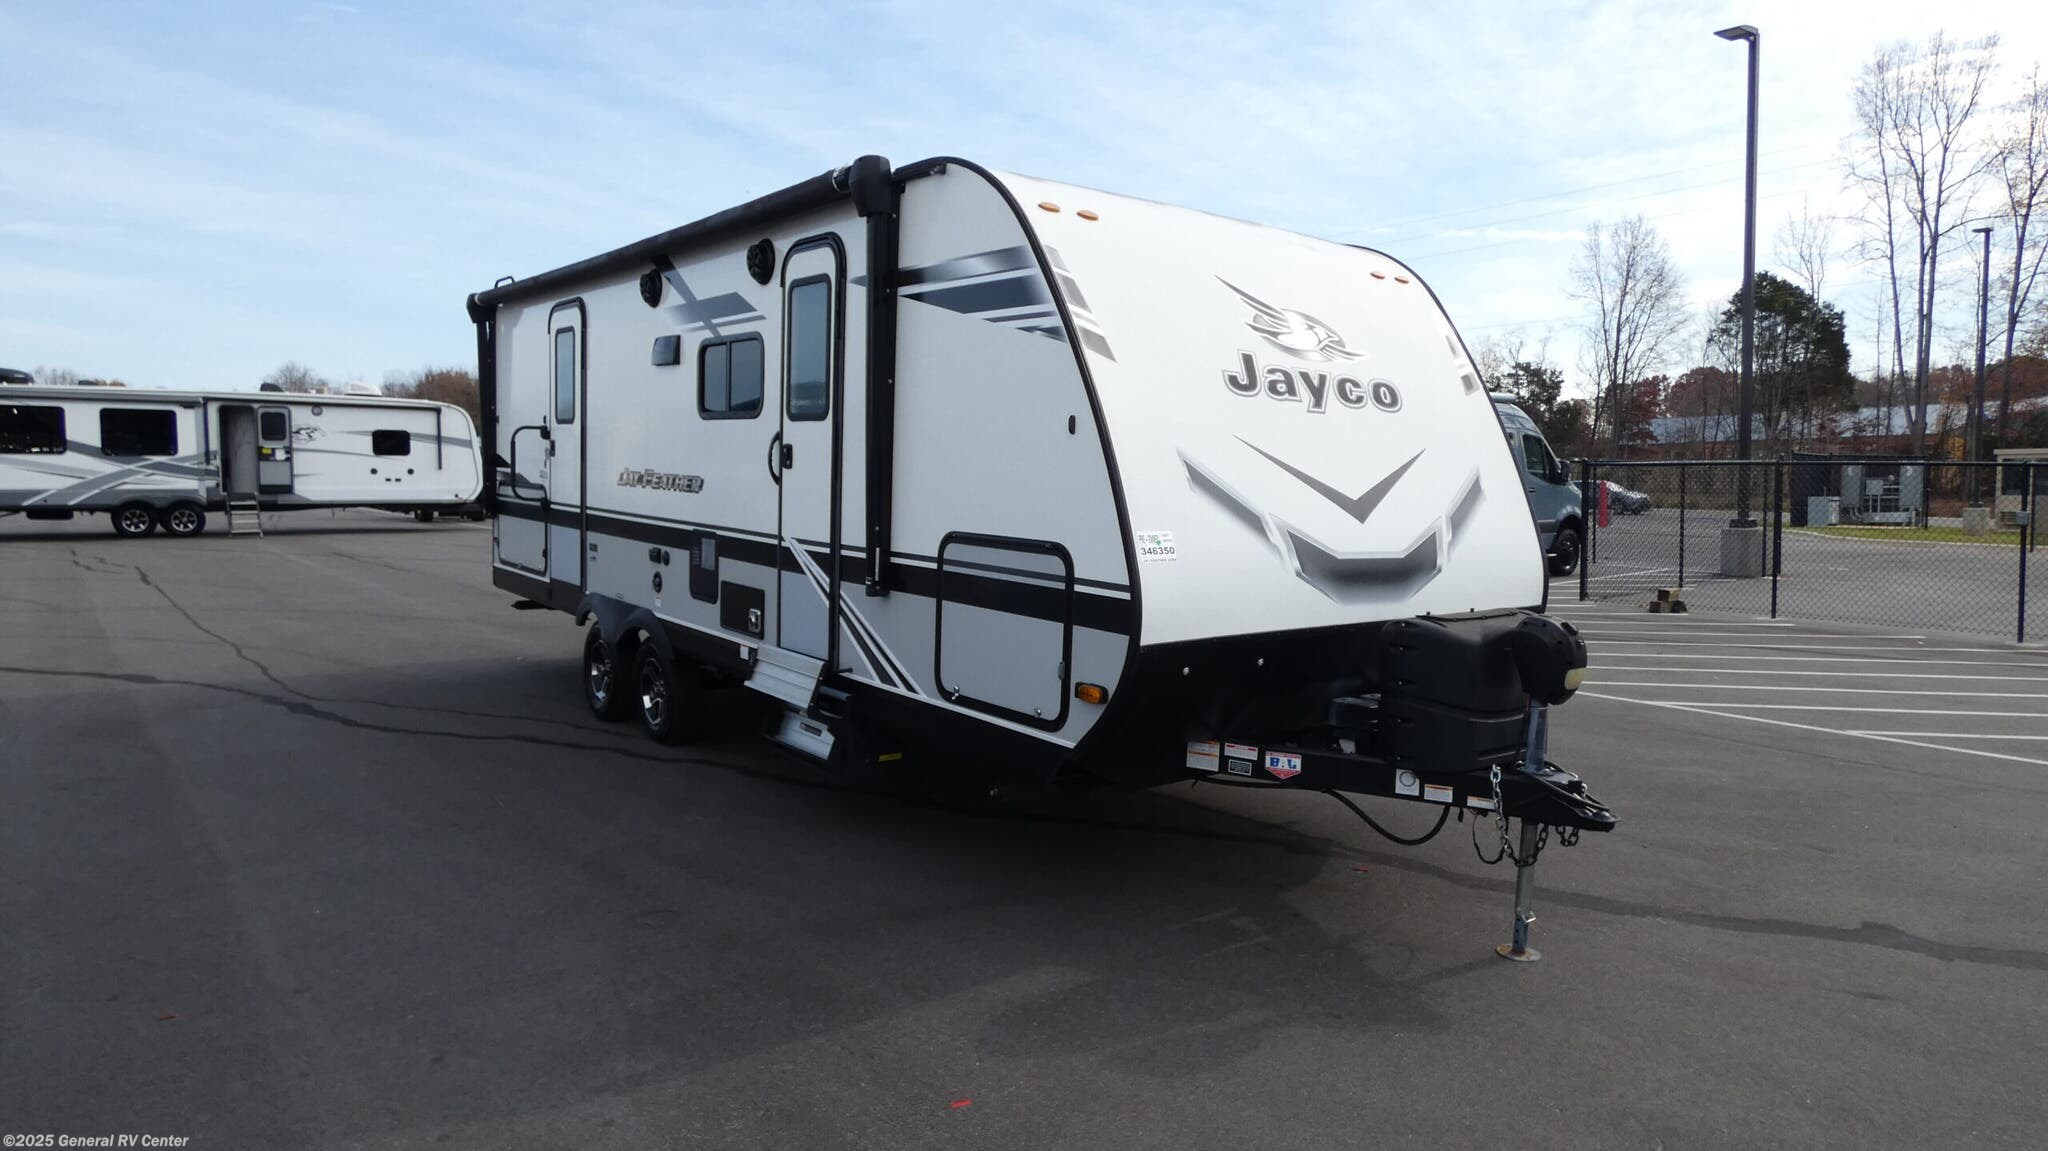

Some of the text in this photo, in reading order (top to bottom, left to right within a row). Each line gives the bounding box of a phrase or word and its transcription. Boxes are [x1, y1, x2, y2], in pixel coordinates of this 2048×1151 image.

[1222, 349, 1402, 414] Jayco
[617, 467, 704, 494] JAY FEATHER
[1141, 546, 1175, 556] 346350
[1270, 757, 1297, 769] BL
